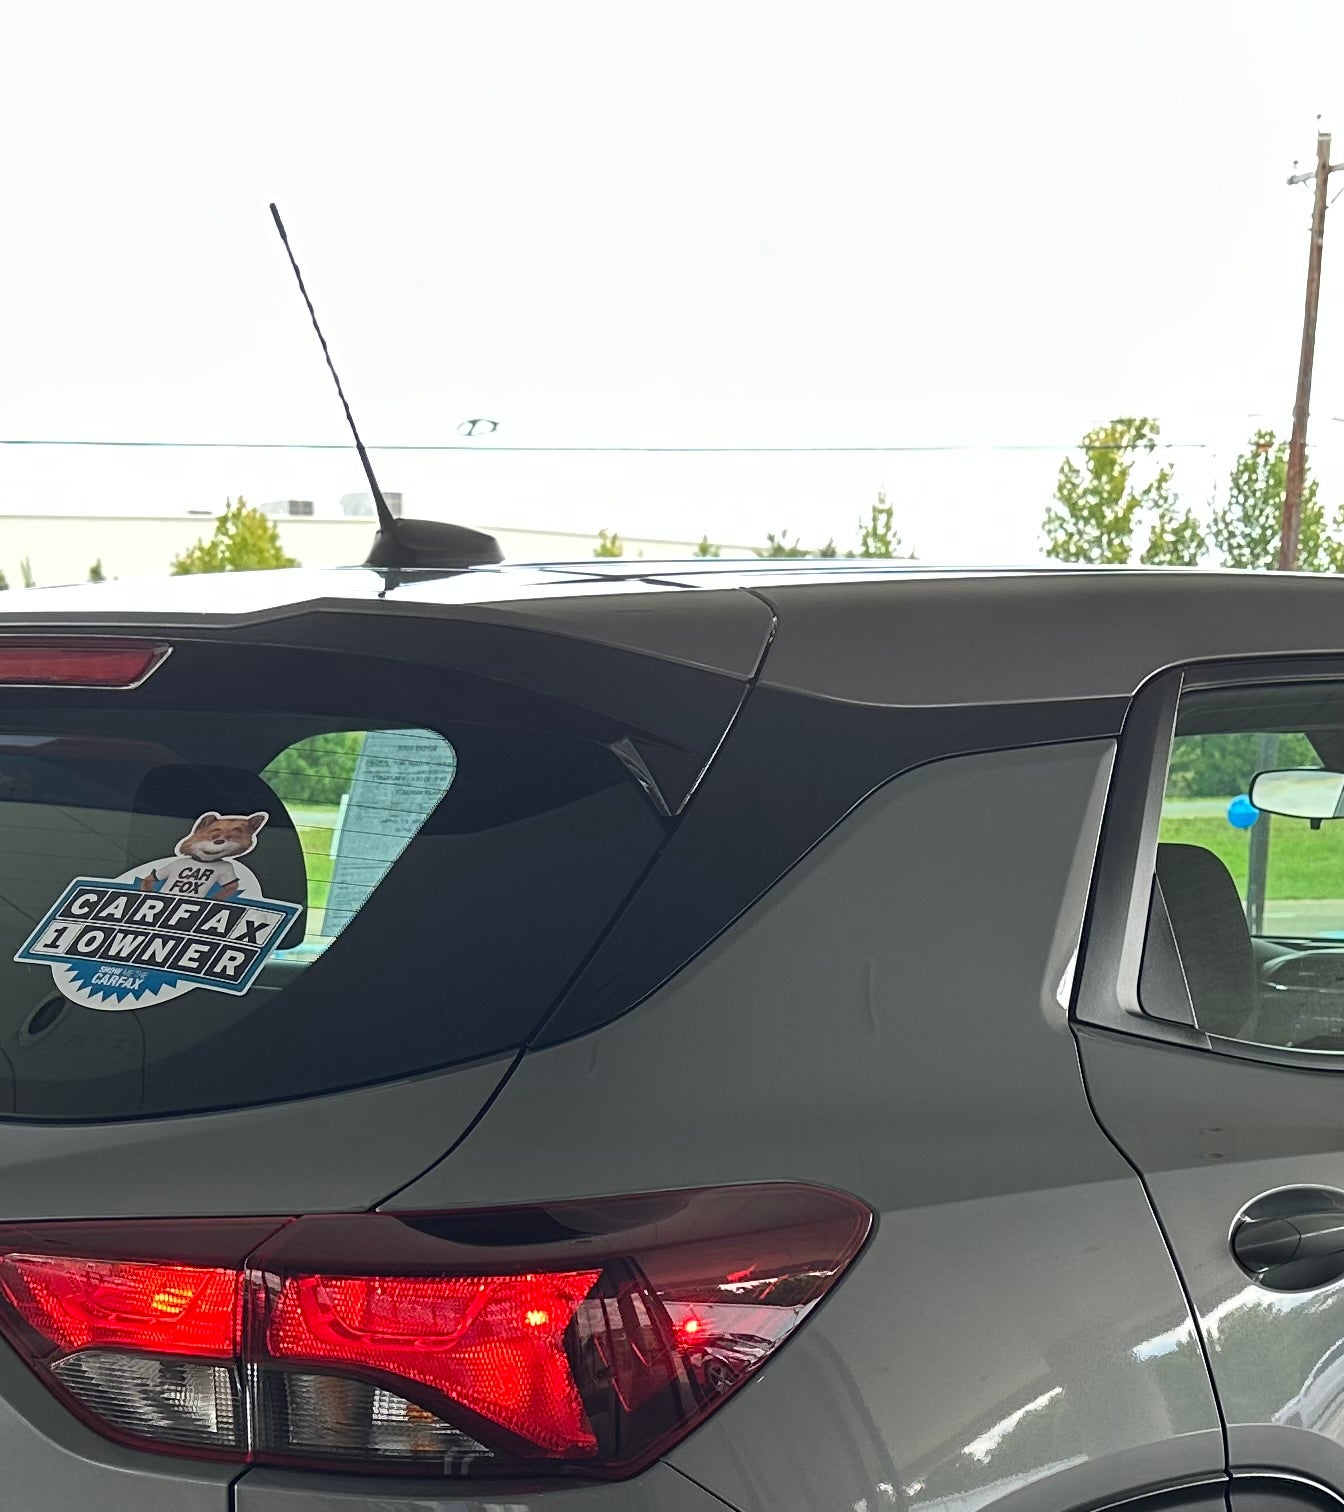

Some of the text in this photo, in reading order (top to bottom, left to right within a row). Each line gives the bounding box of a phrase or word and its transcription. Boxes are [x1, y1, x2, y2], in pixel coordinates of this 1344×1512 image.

[178, 866, 214, 882] CAR
[168, 879, 204, 895] FOX
[70, 893, 270, 945] CARFAX
[43, 926, 246, 976] 1 OWNER
[98, 965, 123, 976] SHOW
[91, 972, 144, 990] CARFAX
